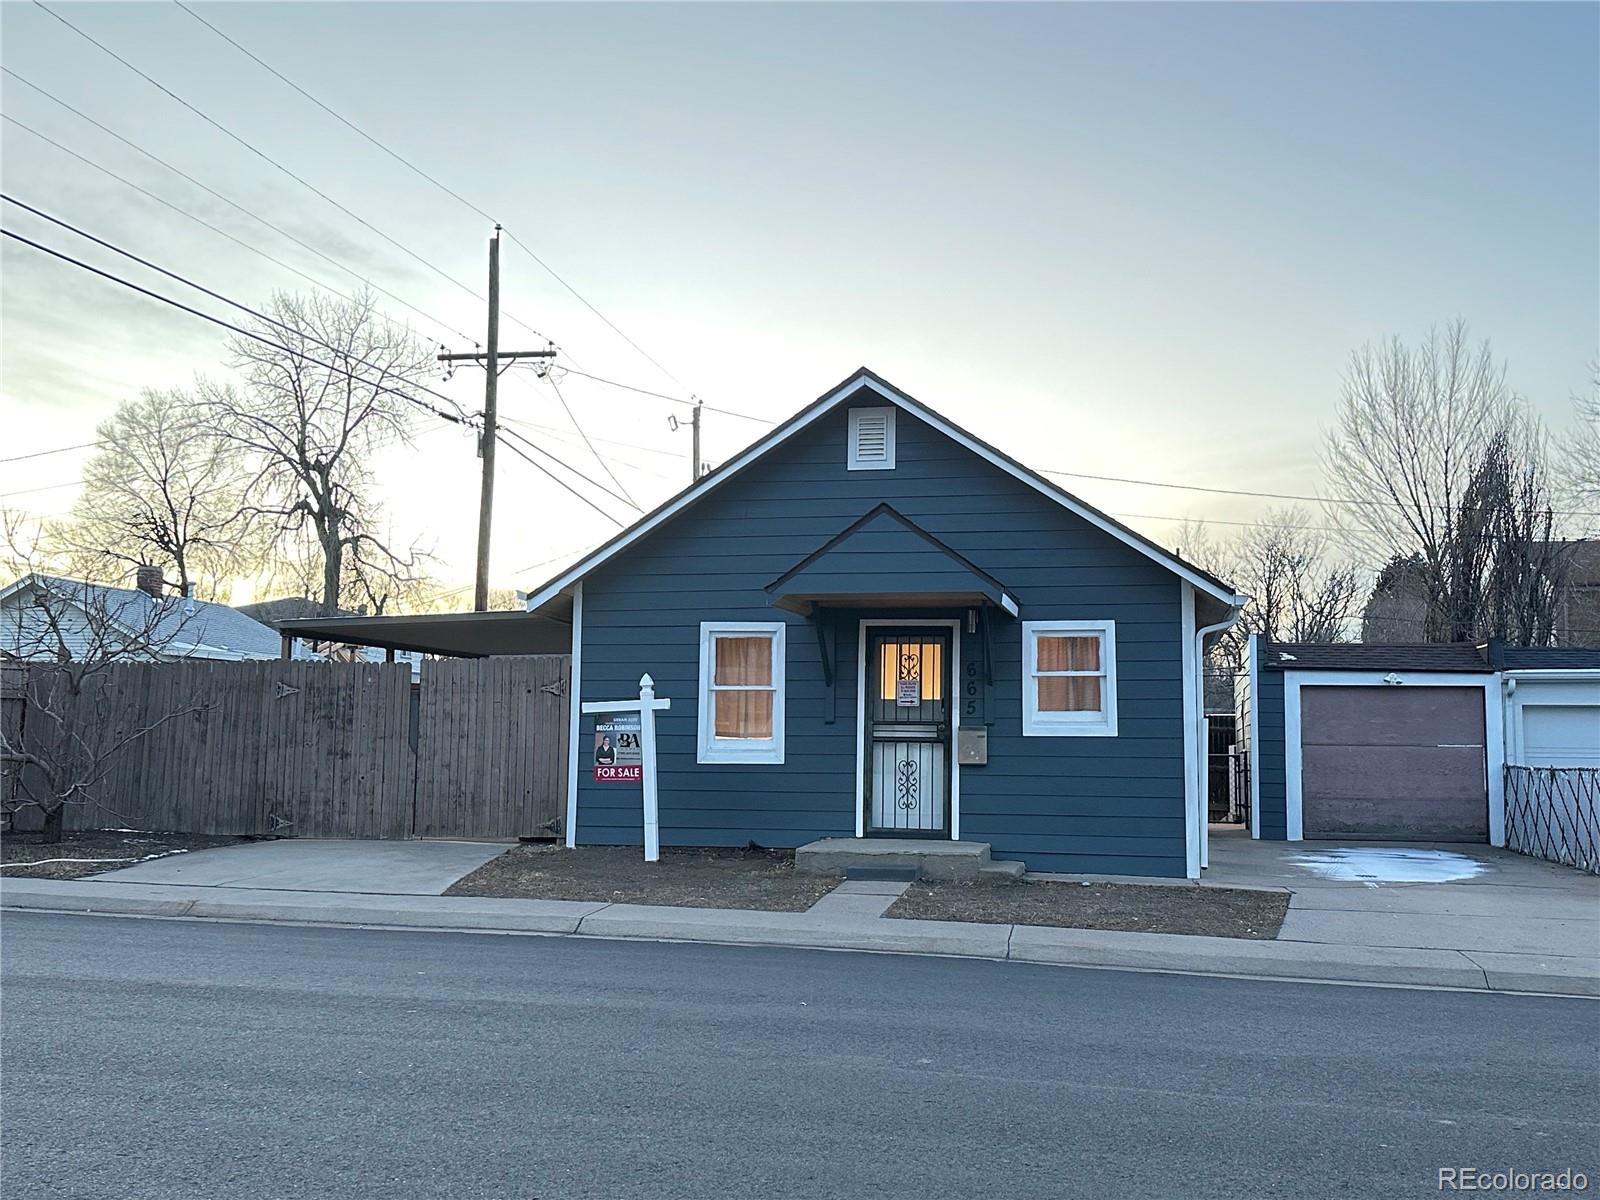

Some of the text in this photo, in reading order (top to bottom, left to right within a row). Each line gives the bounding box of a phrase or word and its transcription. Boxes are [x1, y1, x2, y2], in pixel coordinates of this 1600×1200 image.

[966, 662, 977, 715] 665
[597, 767, 640, 777] FOR SALE
